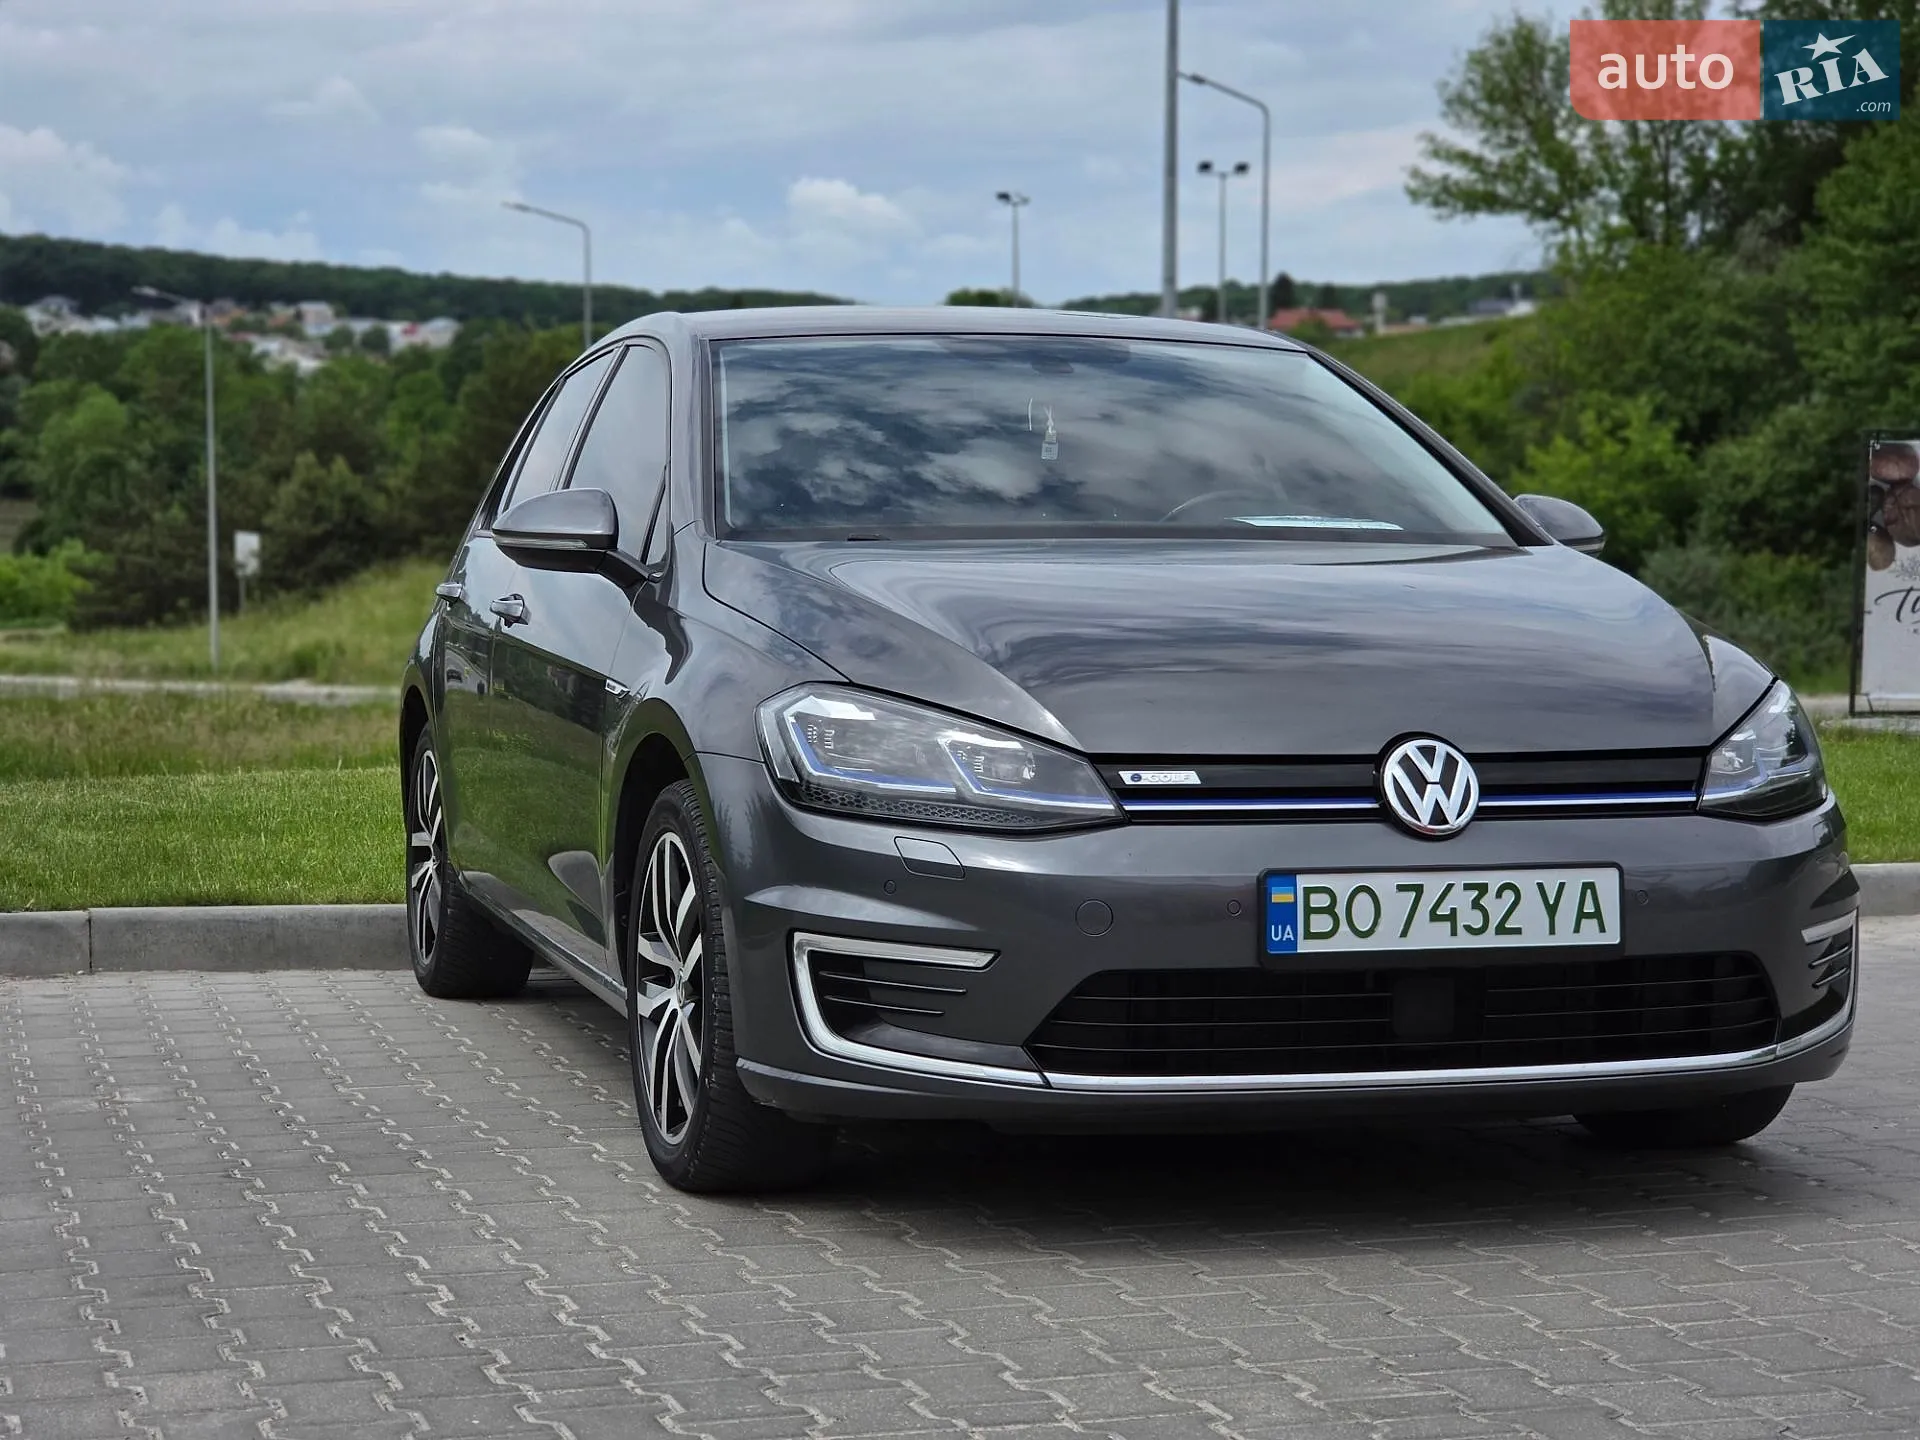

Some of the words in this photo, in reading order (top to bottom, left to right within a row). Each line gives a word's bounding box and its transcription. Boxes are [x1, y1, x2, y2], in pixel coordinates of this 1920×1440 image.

[1387, 741, 1475, 831] VW
[1271, 924, 1295, 941] UA
[1302, 885, 1382, 940] BO
[1395, 881, 1523, 938] 7432
[1536, 880, 1607, 934] YA
